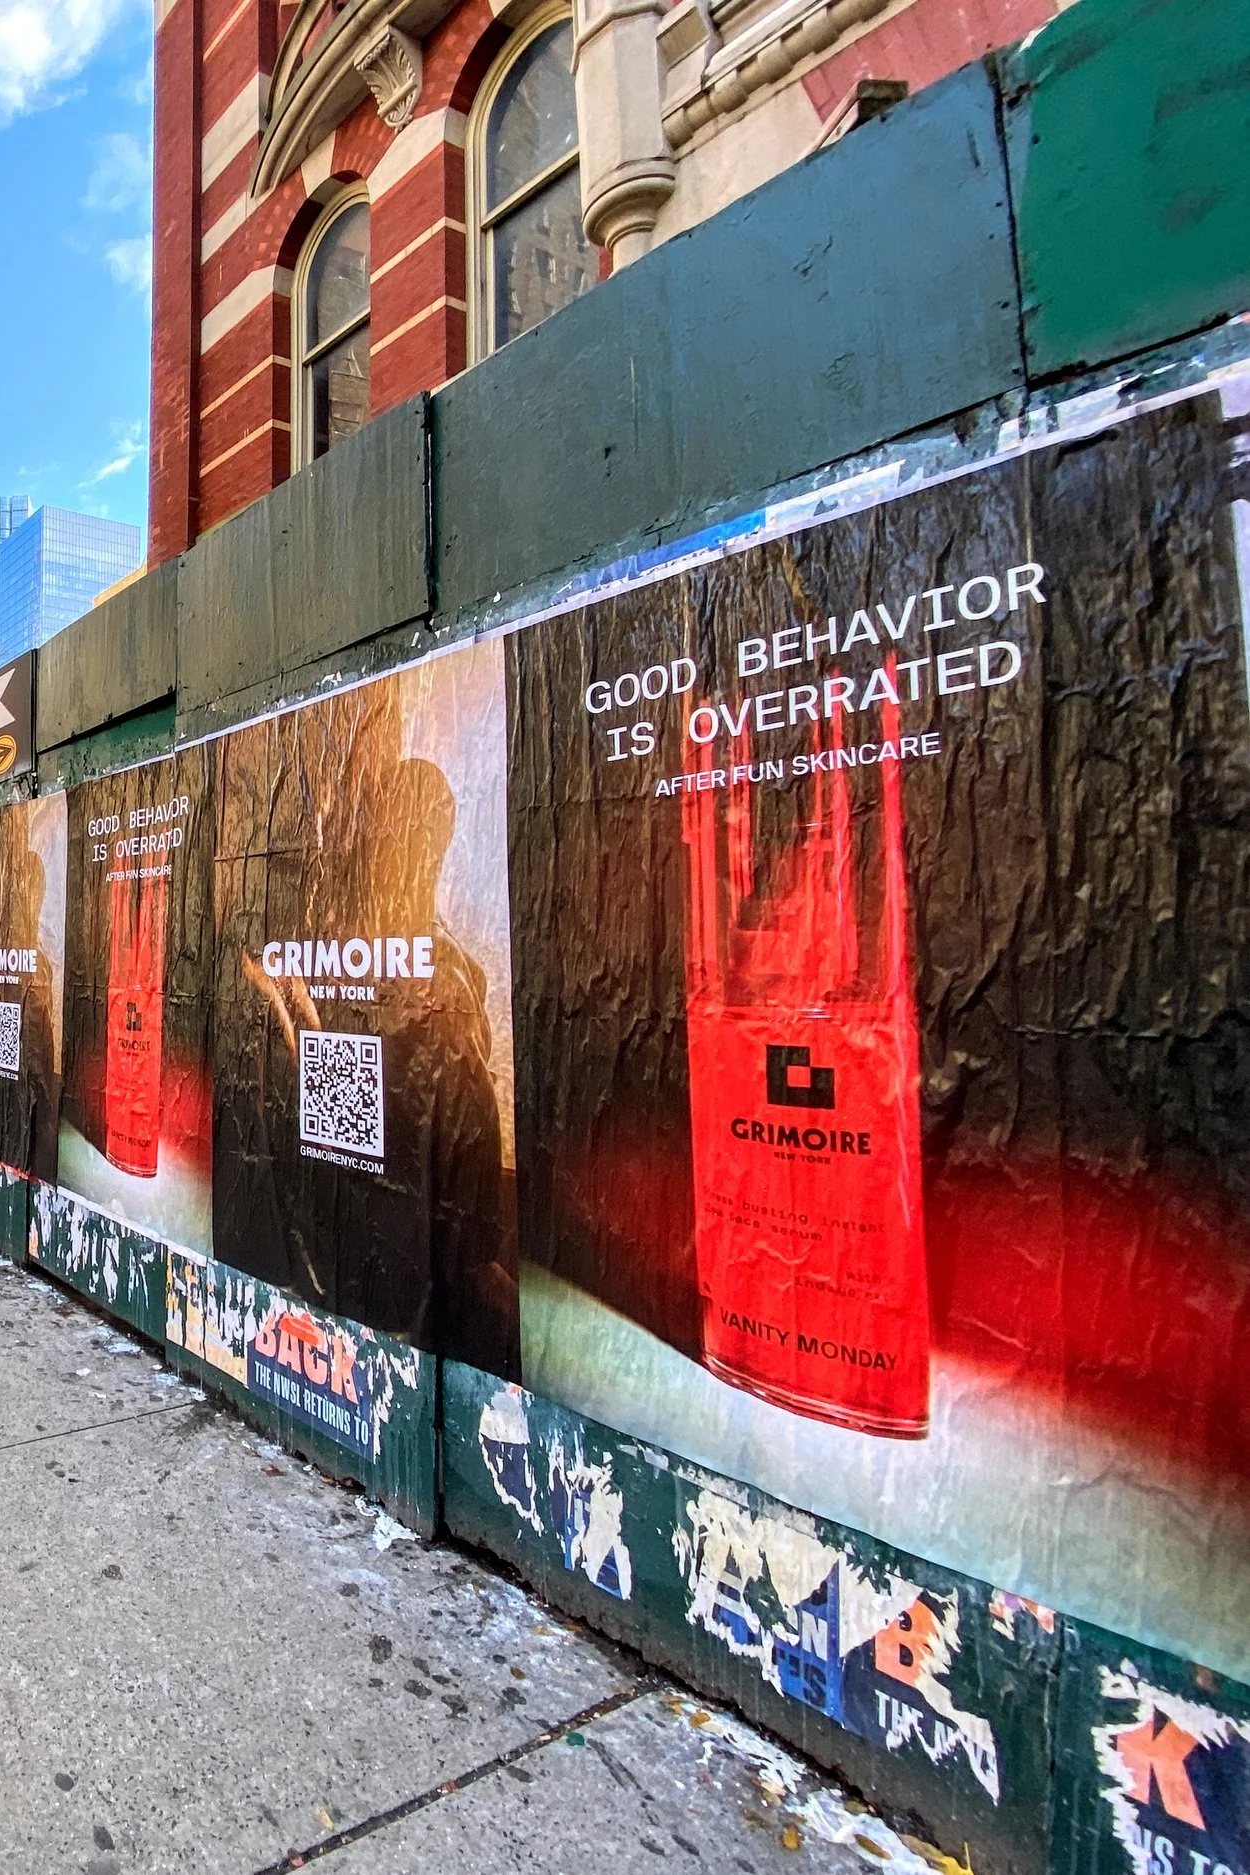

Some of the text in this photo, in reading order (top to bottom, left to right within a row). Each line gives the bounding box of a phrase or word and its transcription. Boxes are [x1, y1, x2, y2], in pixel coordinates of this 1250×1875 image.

[584, 561, 1048, 715] GOOD BEHAVIOR
[606, 640, 1023, 763] IS OVERRATED
[654, 732, 942, 799] AFTER FUN SKINCARE
[88, 814, 120, 837] GOOD
[92, 844, 108, 862] IS
[262, 936, 436, 978] GRIMOIRE
[309, 984, 375, 1001] NEW YORK
[300, 1145, 385, 1175] GRIMOIRENYC.COM
[730, 1117, 872, 1155] GRIMOIRE
[255, 1312, 359, 1405] BACK
[720, 1305, 898, 1371] VANITY MONDAY
[254, 1360, 271, 1390] THE
[303, 1388, 351, 1436] RETURNS
[354, 1415, 369, 1446] TO
